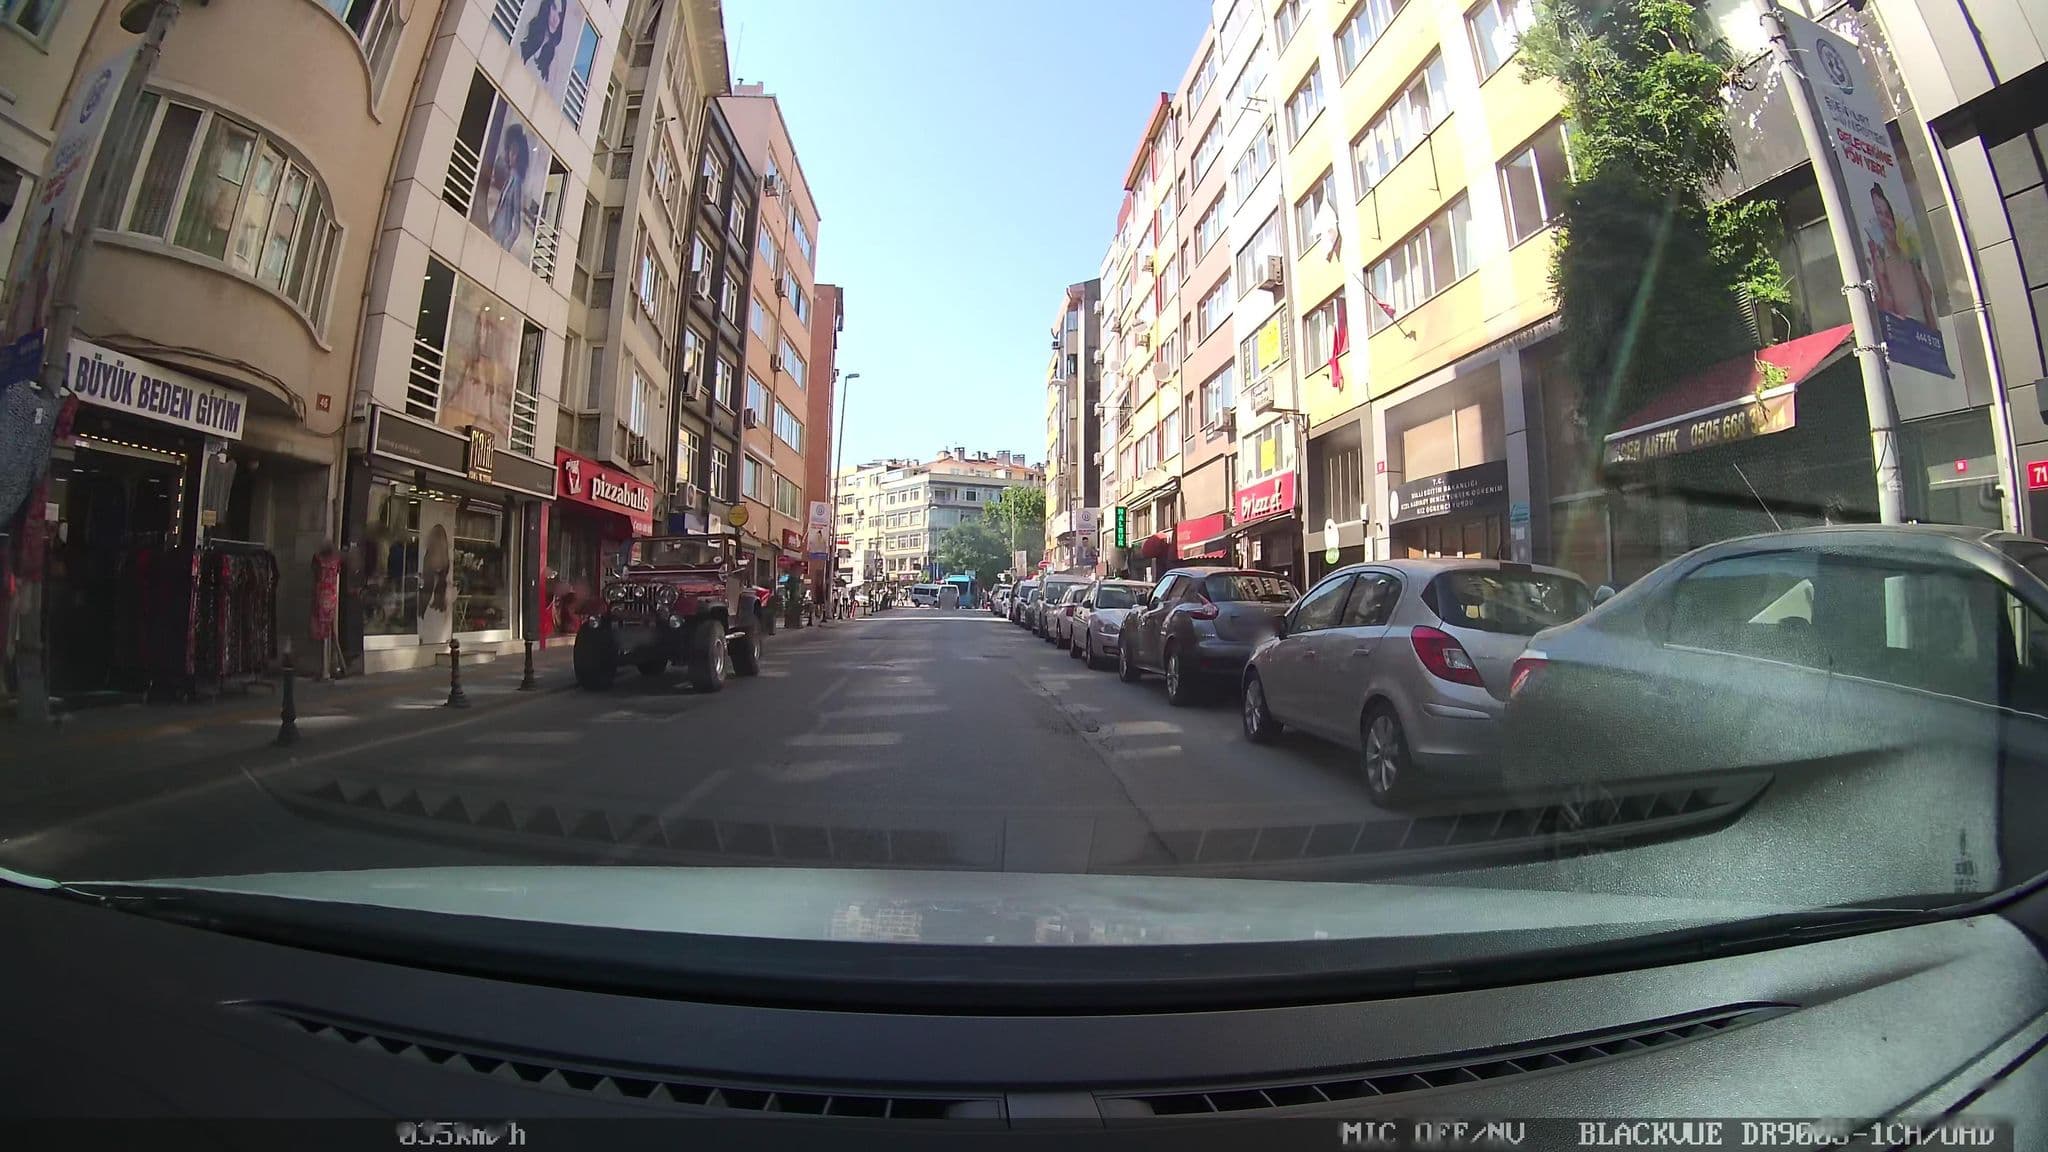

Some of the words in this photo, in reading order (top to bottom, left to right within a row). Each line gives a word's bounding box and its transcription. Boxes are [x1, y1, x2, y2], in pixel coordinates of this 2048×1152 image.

[74, 353, 137, 406] BÜYÜK
[137, 374, 193, 421] BEDEN
[196, 389, 241, 433] GİYİM
[592, 473, 650, 512] pizzabulls
